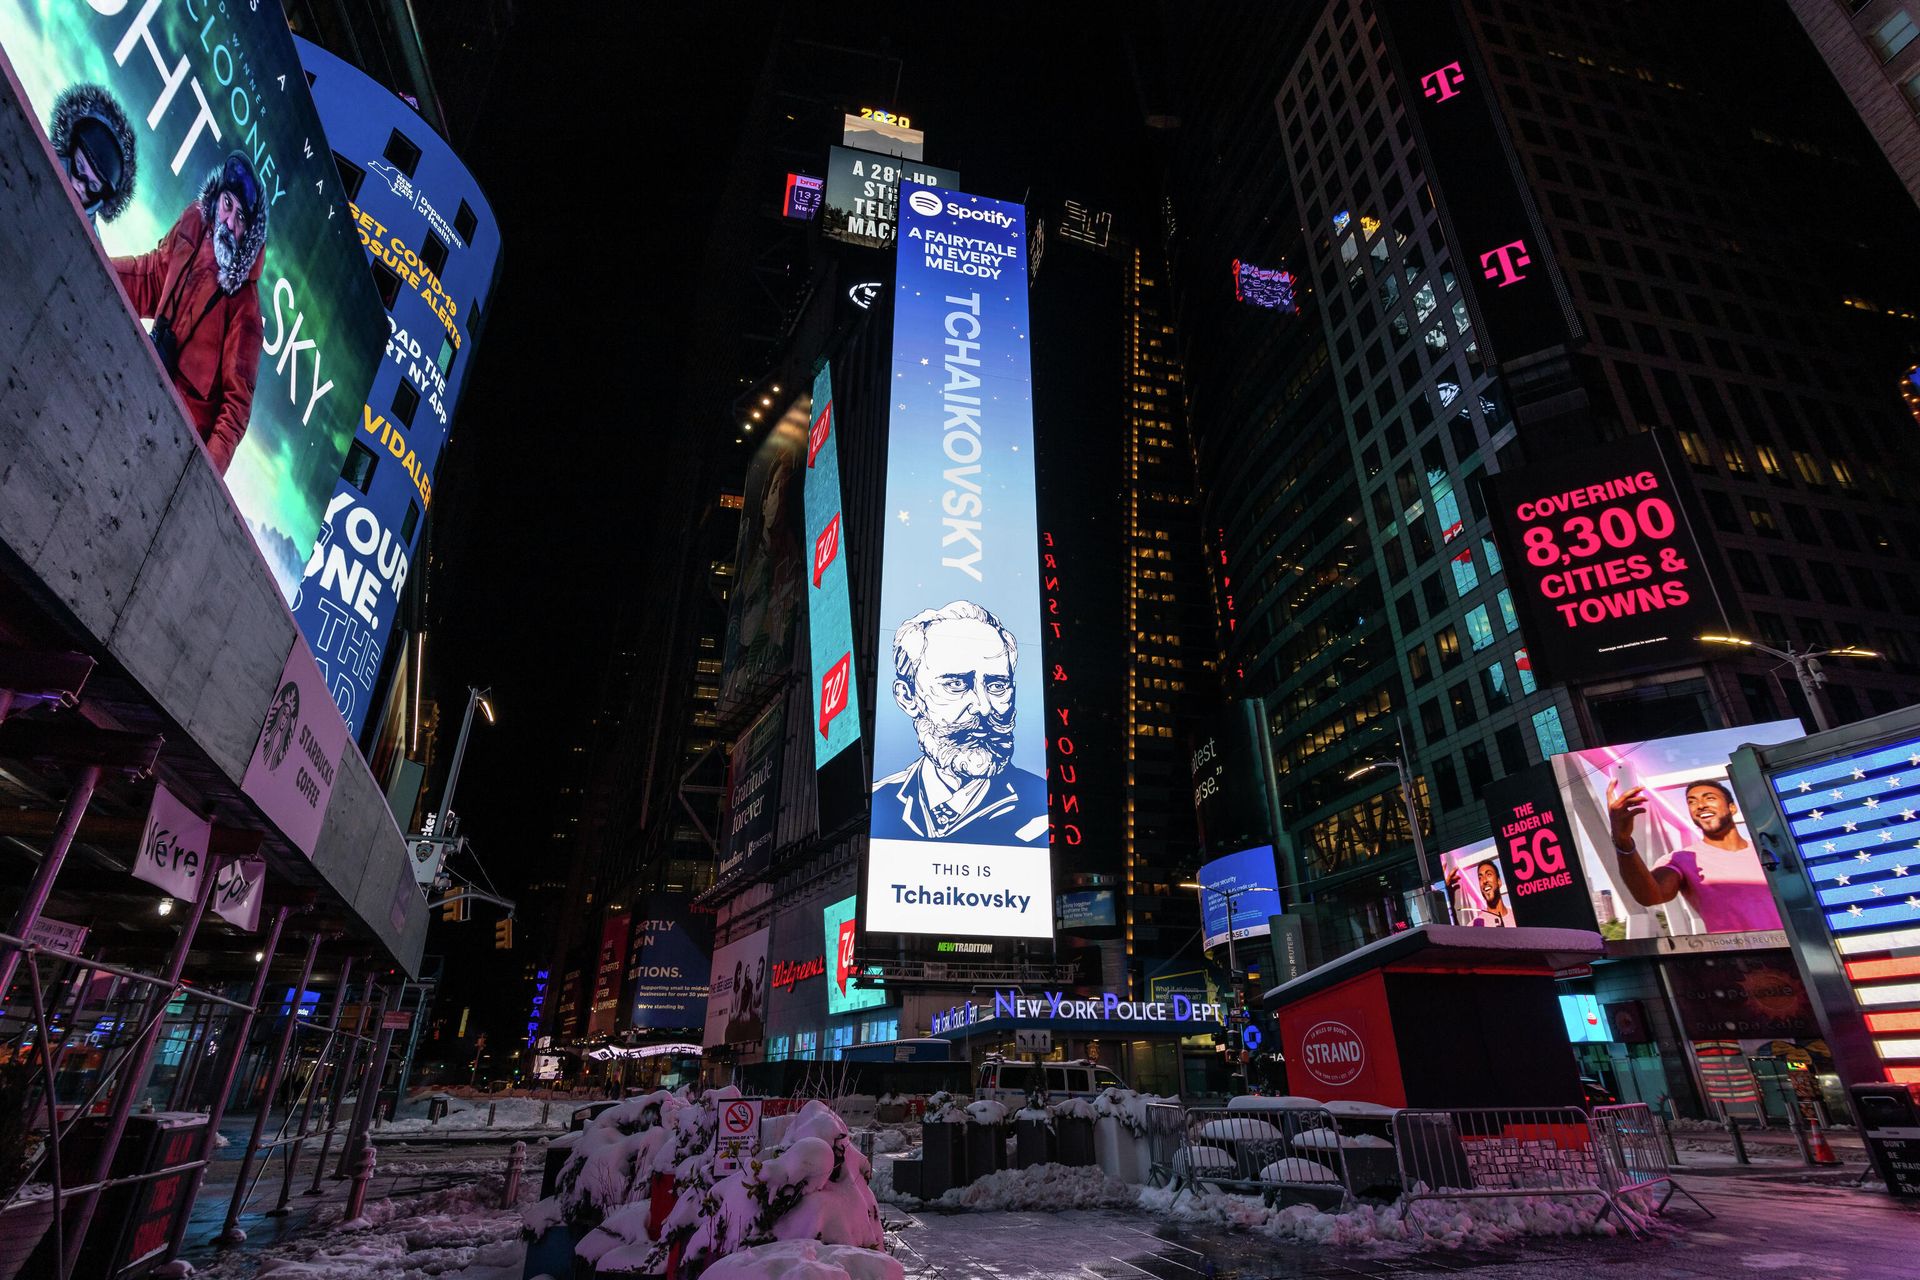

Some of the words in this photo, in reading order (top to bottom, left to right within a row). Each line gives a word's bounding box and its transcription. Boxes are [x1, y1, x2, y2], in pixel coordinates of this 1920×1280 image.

[87, 0, 222, 177] HT
[232, 33, 267, 118] WINNER
[861, 107, 911, 129] 2020
[396, 174, 412, 189] NEW
[852, 160, 864, 177] A
[394, 183, 414, 202] STATE
[418, 206, 428, 216] of
[427, 215, 451, 245] Health
[420, 196, 462, 250] Department
[945, 203, 1014, 229] Spotify
[348, 201, 388, 238] GET
[390, 237, 458, 316] COVID-19
[908, 227, 922, 240] A
[925, 230, 1017, 258] FAIRYTALE
[924, 242, 943, 257] IN
[947, 248, 1003, 268] EVERY
[925, 256, 1002, 281] MELODY
[421, 288, 463, 351] ALERTS
[262, 277, 334, 427] SKY
[408, 361, 430, 393] NY
[425, 355, 446, 397] THE
[942, 292, 982, 583] TCHAIKOVSKY
[1516, 471, 1658, 521] COVERING
[322, 492, 409, 603] YOUR
[1523, 497, 1676, 567] 8,300
[1540, 554, 1653, 599] CITIES
[1658, 547, 1688, 573] &
[1556, 580, 1690, 628] TOWNS
[317, 596, 381, 692] THE
[299, 724, 335, 787] STARBUCKS
[296, 766, 321, 809] COFFEE
[731, 756, 774, 810] Gratitude
[731, 794, 766, 837] forever
[1502, 815, 1541, 838] LEADER
[1541, 811, 1555, 824] IN
[1513, 801, 1535, 819] THE
[145, 817, 199, 878] We're
[1509, 827, 1568, 881] 5G
[932, 863, 970, 876] THIS
[977, 865, 992, 877] IS
[1515, 872, 1573, 897] COVERAGE
[891, 884, 1031, 913] Tchaikovsky
[1225, 929, 1243, 941] CASE
[1286, 931, 1296, 964] REUTERS
[1709, 937, 1751, 947] THOMSON
[1752, 935, 1787, 944] REUTER
[771, 953, 826, 994] Walgreens
[930, 1013, 940, 1034] NEW
[940, 1009, 951, 1032] YORK
[950, 1005, 964, 1030] POLICE
[964, 1000, 979, 1025] DEPT
[995, 989, 1042, 1019] NEW
[1043, 991, 1098, 1019] YORK
[1103, 991, 1167, 1021] POLICE
[1173, 992, 1221, 1022] DEPT
[1305, 1040, 1361, 1065] STRAND
